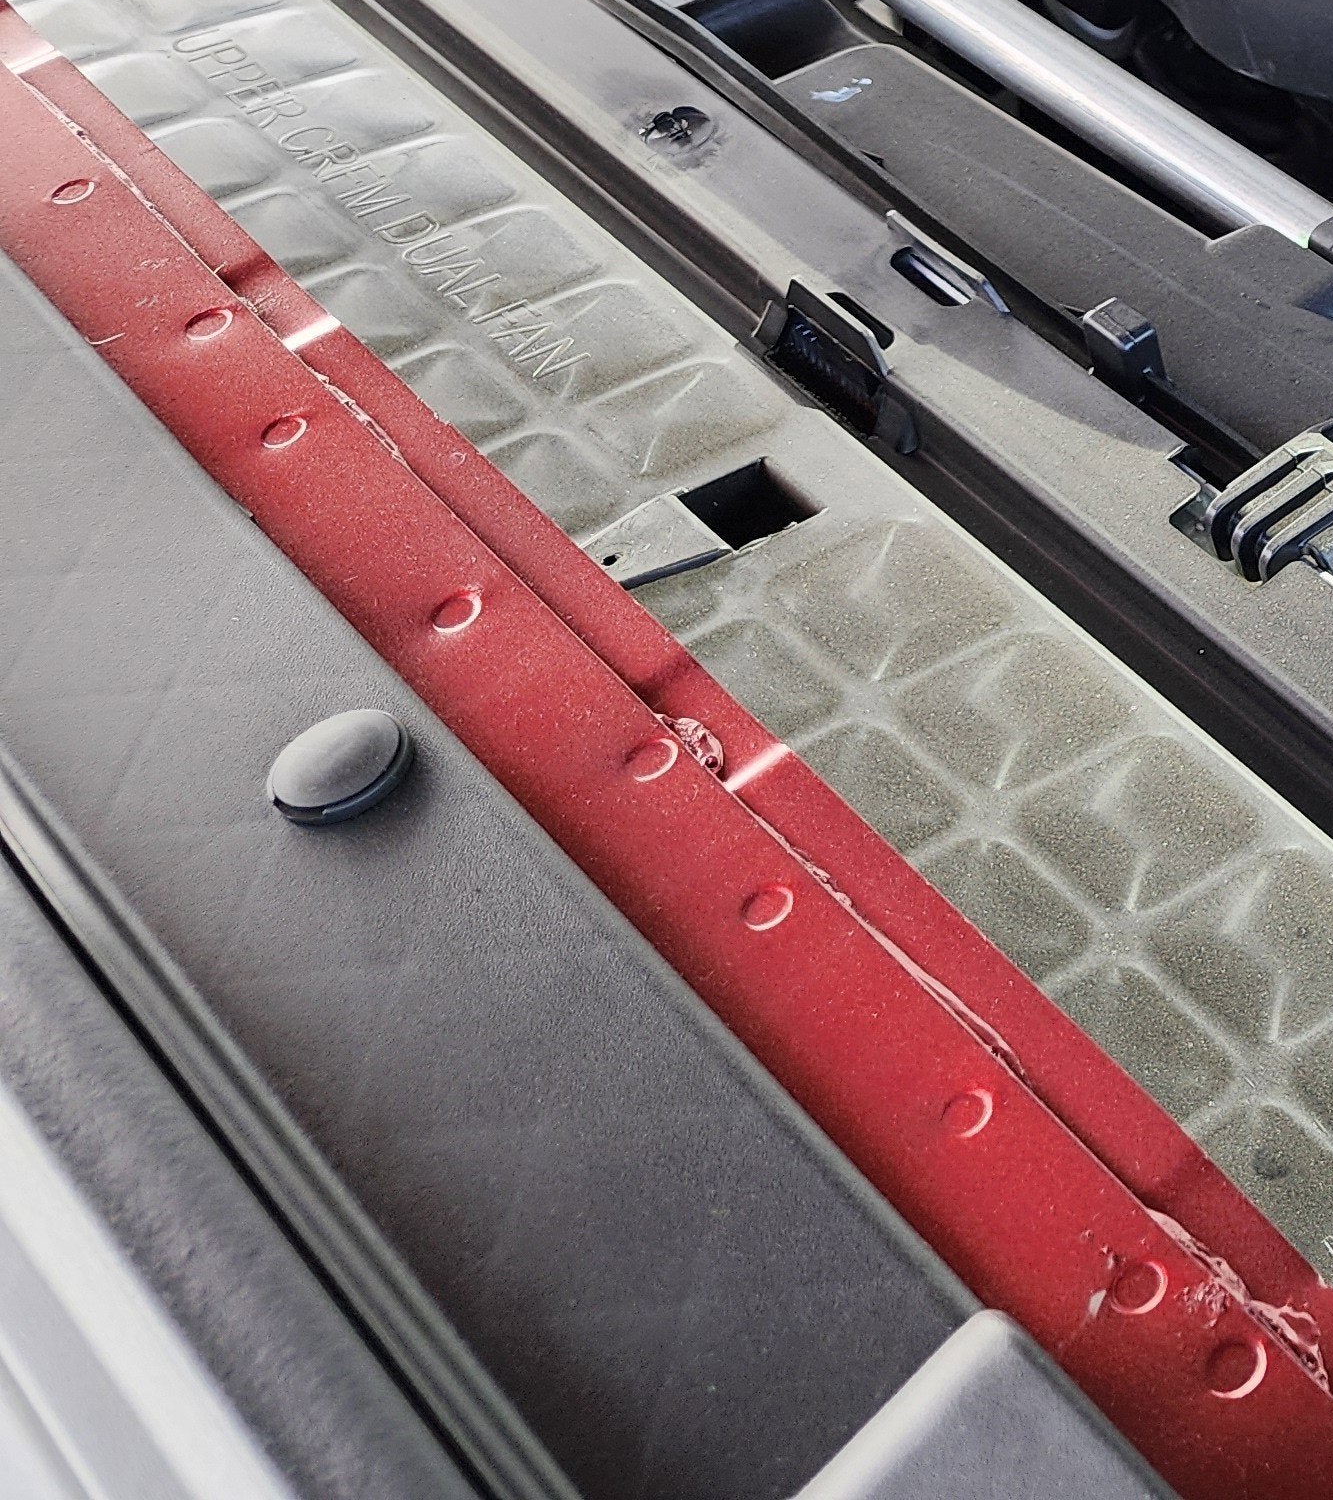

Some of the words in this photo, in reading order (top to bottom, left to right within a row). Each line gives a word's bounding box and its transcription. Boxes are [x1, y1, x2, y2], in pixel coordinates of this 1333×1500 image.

[172, 27, 306, 130] UPPER
[371, 210, 502, 309] DUAL
[472, 298, 591, 379] FAN
